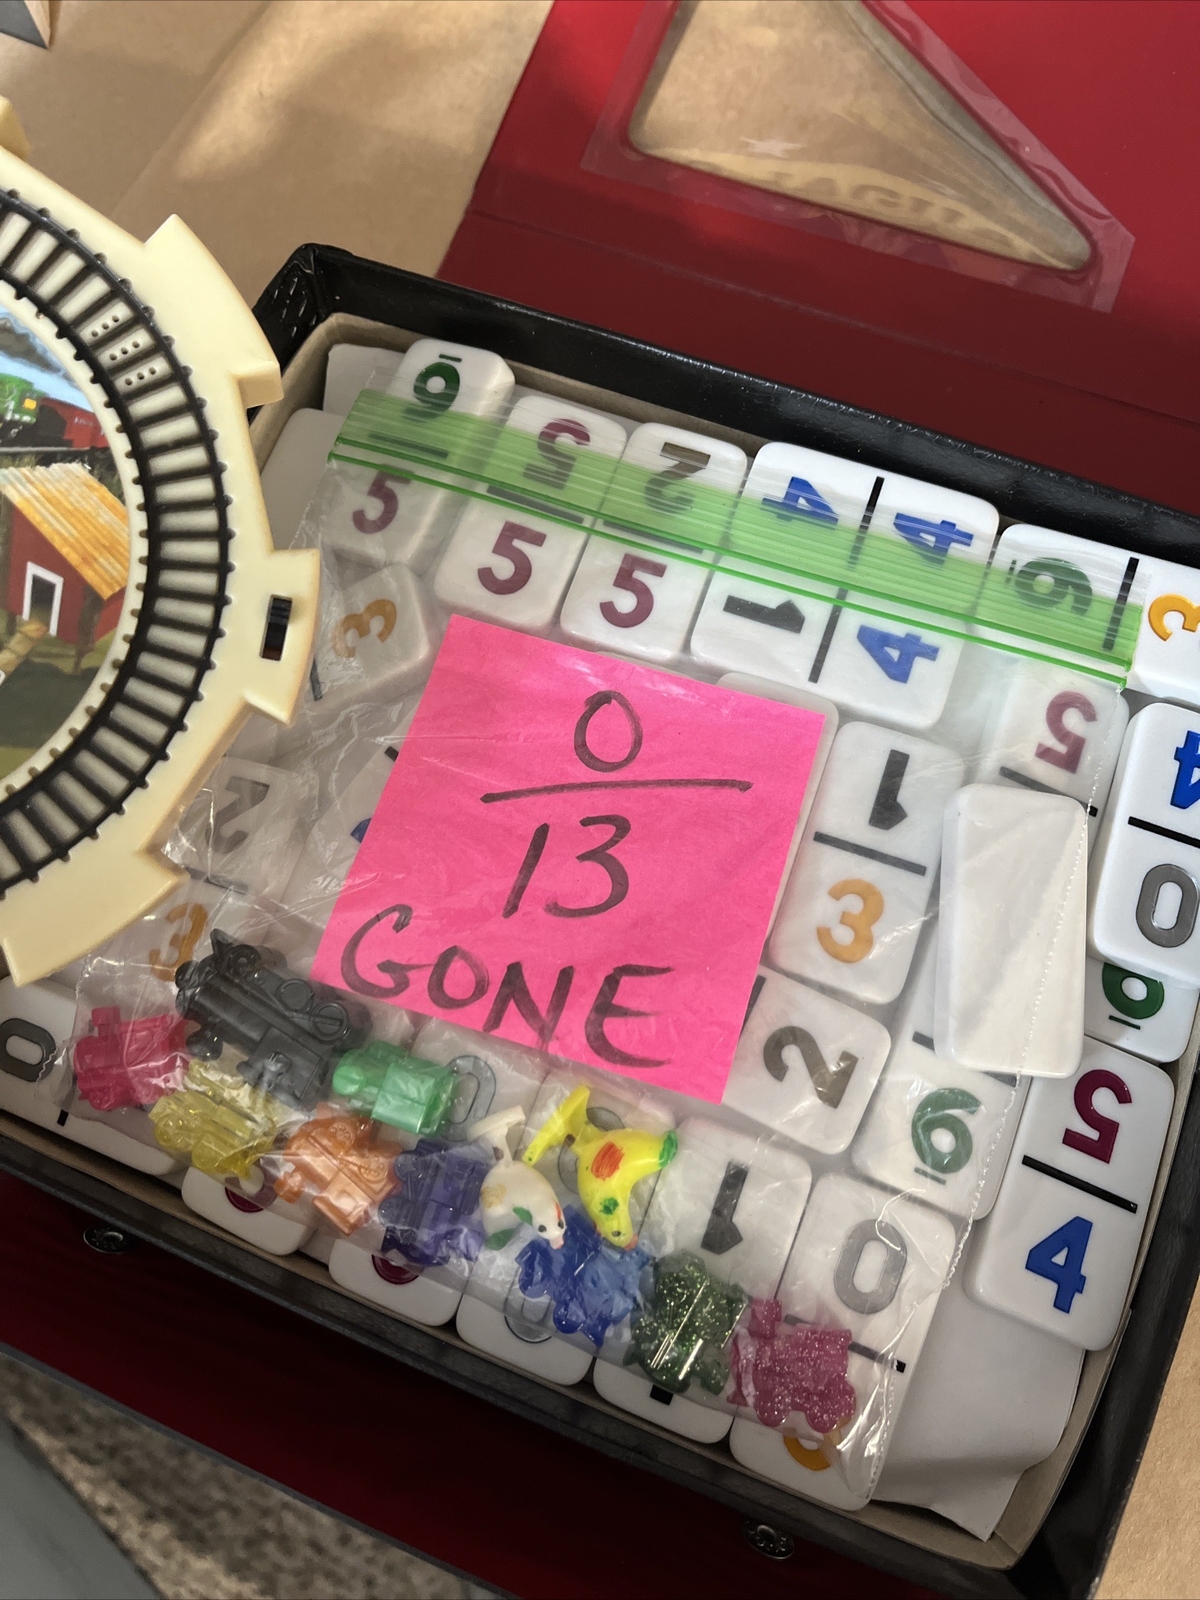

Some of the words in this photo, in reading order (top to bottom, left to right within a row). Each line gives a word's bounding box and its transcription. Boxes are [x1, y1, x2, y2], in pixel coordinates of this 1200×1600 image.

[523, 418, 591, 491] 5
[644, 442, 711, 515] 2
[352, 463, 414, 535] 5
[760, 476, 840, 530] 4
[893, 512, 974, 566] 4
[477, 521, 547, 595] 5
[599, 553, 667, 628] 5
[330, 598, 398, 659] 3
[723, 595, 806, 634] 1
[856, 625, 940, 684] 4
[573, 689, 644, 773] 0
[1035, 690, 1098, 775] 5
[204, 774, 271, 855] 2
[868, 748, 911, 831] 1
[502, 814, 632, 919] 13
[1135, 863, 1200, 948] 0
[148, 901, 208, 983] 3
[816, 878, 885, 964] 3
[340, 904, 674, 1069] GONE
[0, 1017, 56, 1083] 0
[762, 1025, 859, 1110] 2
[911, 1087, 982, 1185] 6
[1061, 1068, 1133, 1164] 5
[701, 1159, 750, 1256] 1
[833, 1218, 909, 1315] 0
[1024, 1215, 1094, 1314] 4
